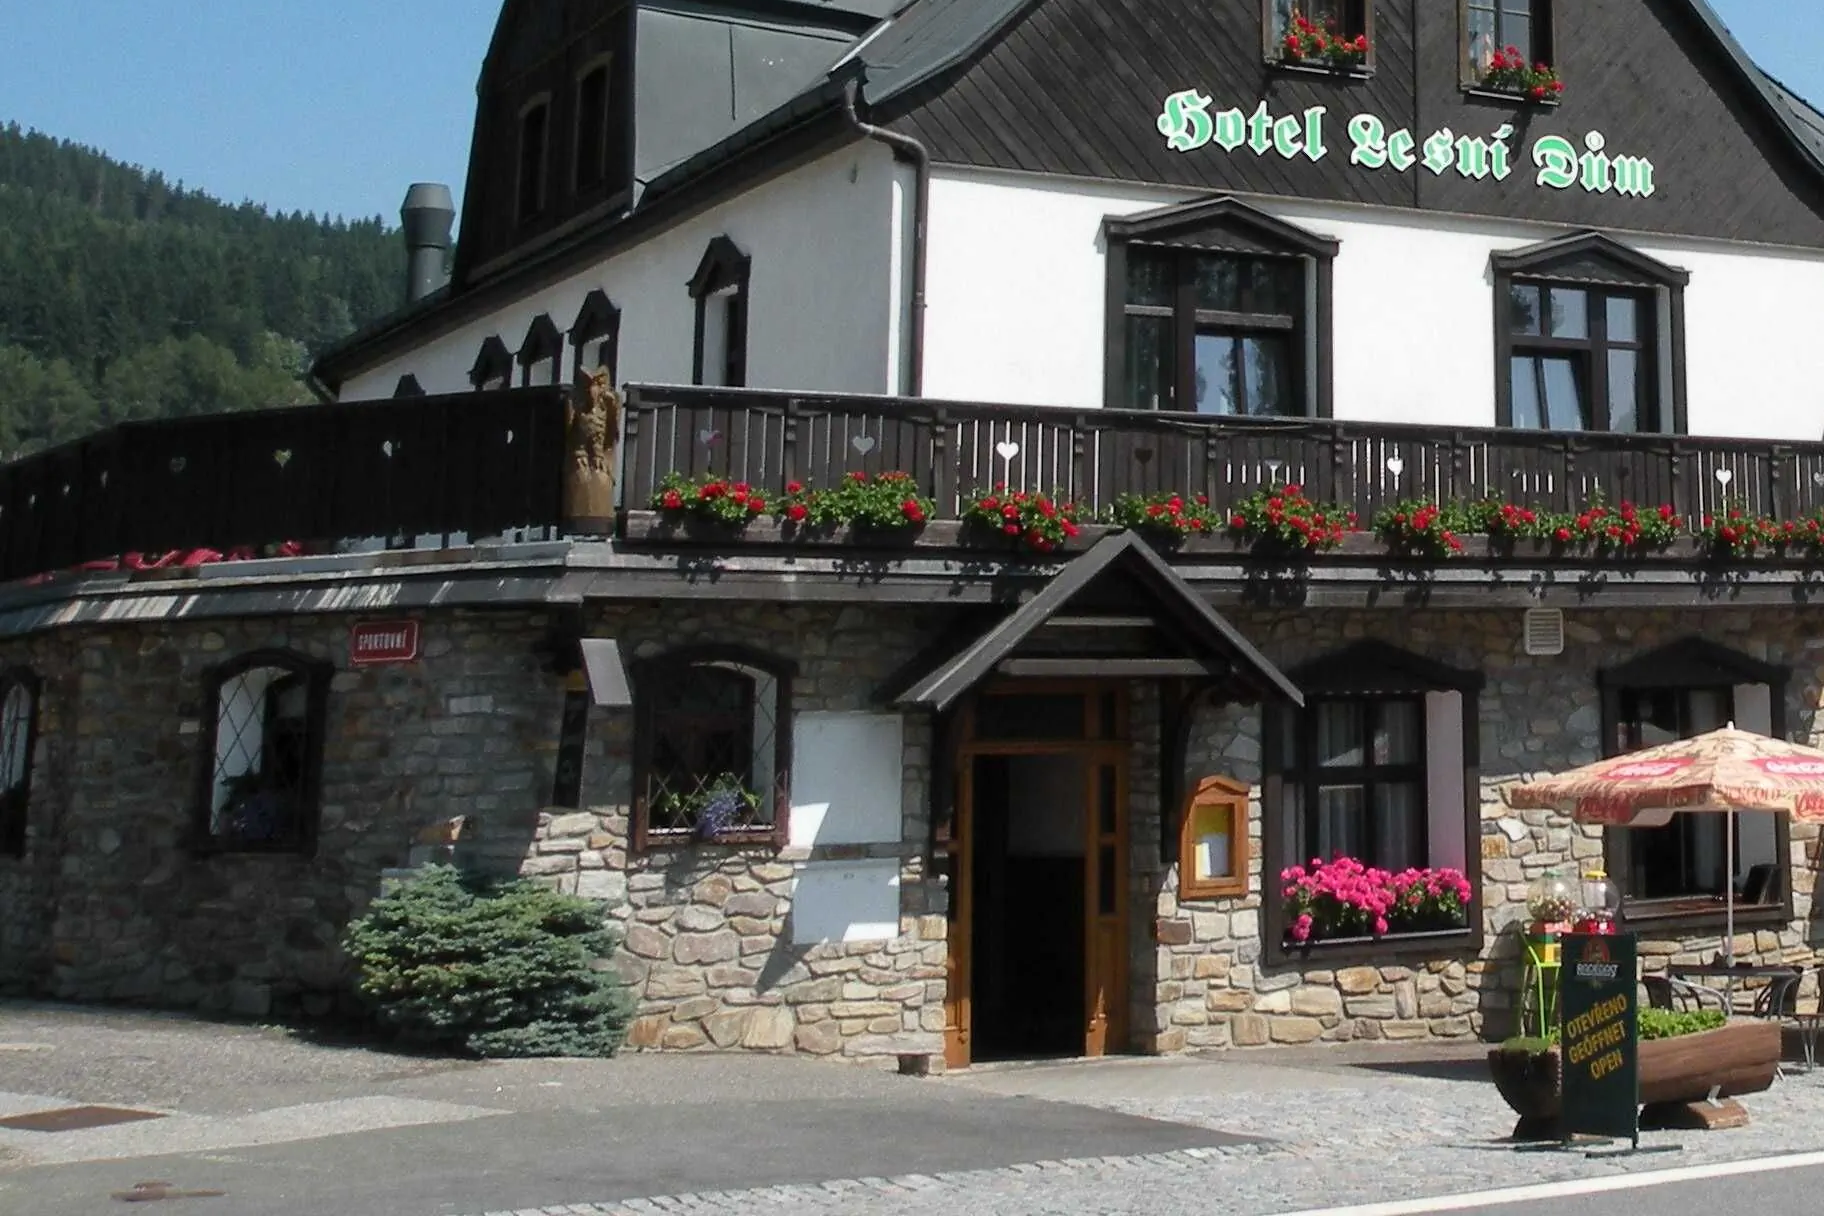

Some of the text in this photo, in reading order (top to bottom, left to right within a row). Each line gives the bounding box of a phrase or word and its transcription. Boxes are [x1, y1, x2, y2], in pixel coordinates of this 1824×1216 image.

[1157, 89, 1656, 198] Hotel Lesní Dům
[1567, 992, 1628, 1039] OTEVŘENO
[1590, 1048, 1624, 1081] OPEN
